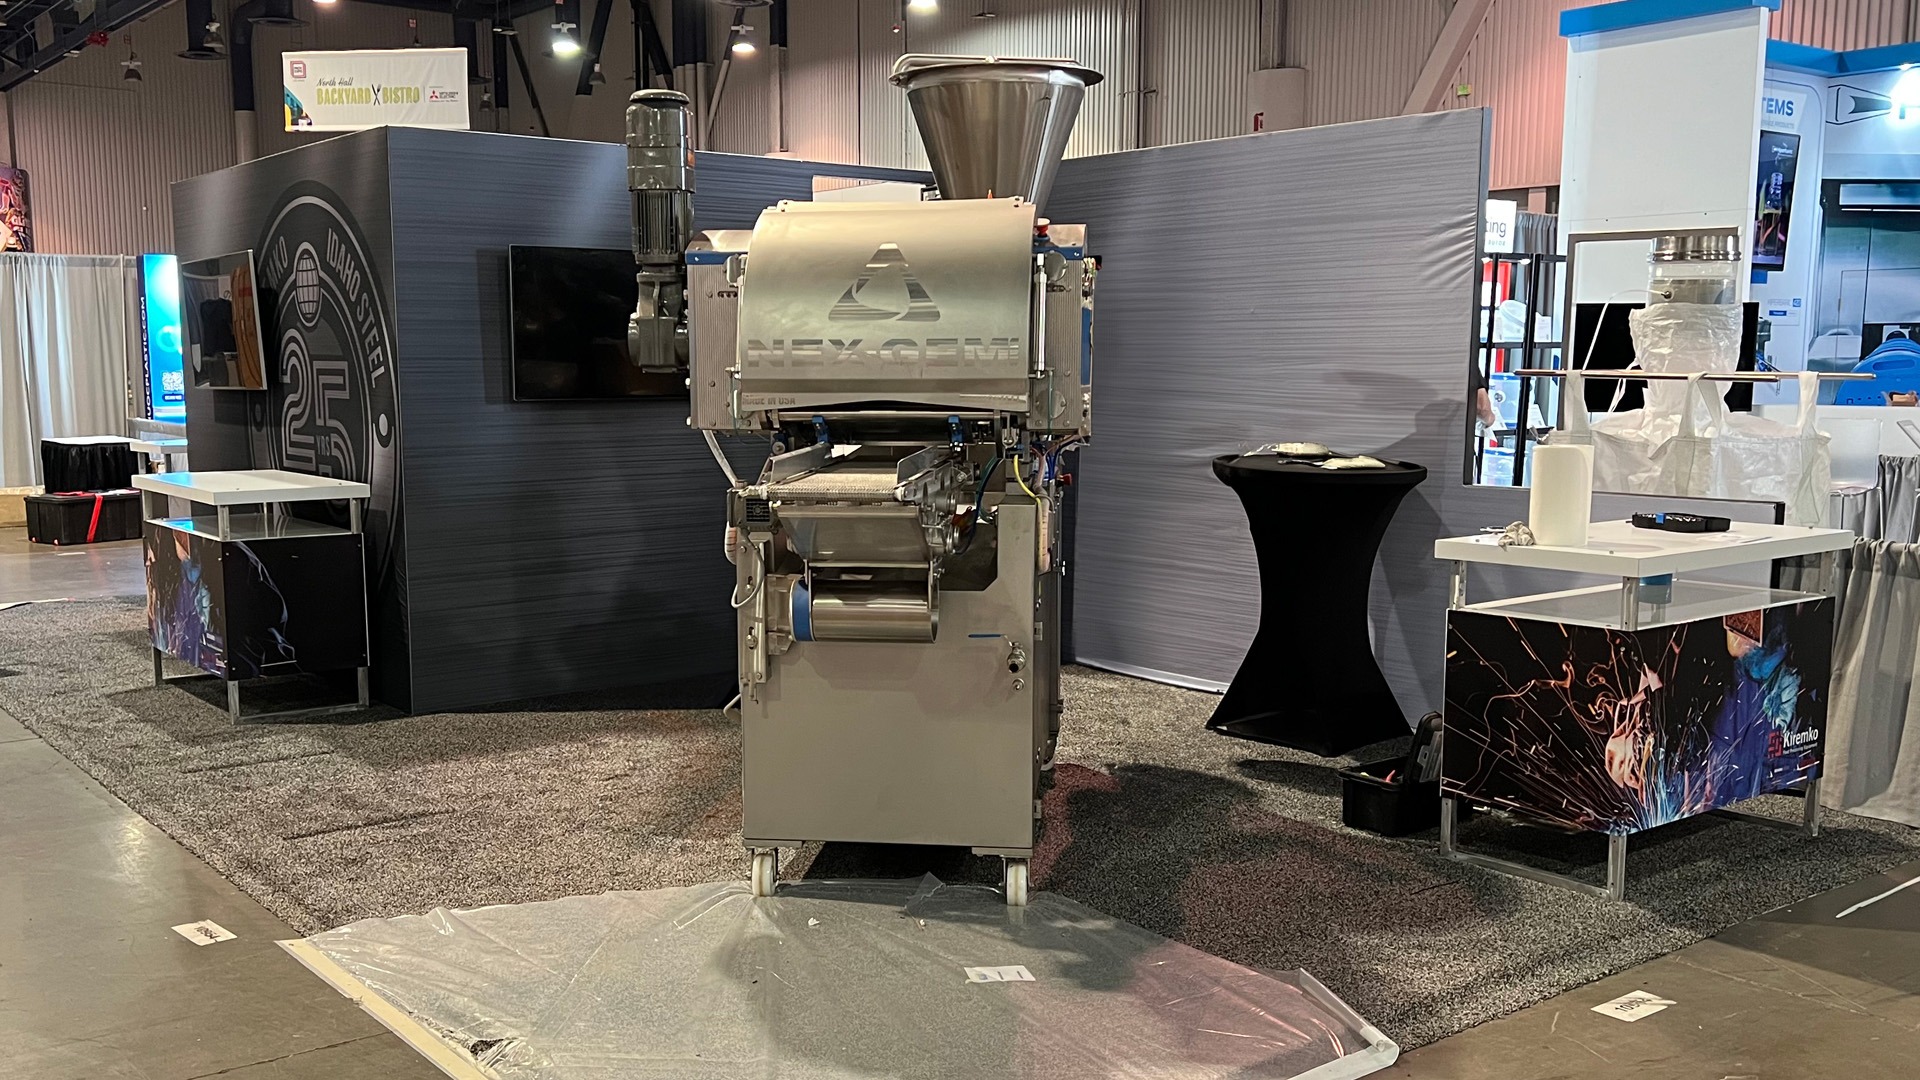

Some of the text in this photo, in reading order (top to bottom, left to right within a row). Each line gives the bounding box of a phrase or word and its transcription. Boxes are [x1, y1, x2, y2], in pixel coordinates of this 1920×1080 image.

[316, 77, 354, 87] North Hall
[316, 86, 420, 105] BACKYARD BISTRO
[327, 227, 361, 302] IDAHO
[356, 292, 385, 389] STEEL
[280, 328, 356, 480] 25
[767, 397, 776, 405] IN
[778, 397, 796, 405] USA
[316, 434, 330, 456] YRS
[1783, 726, 1819, 748] Kiremko
